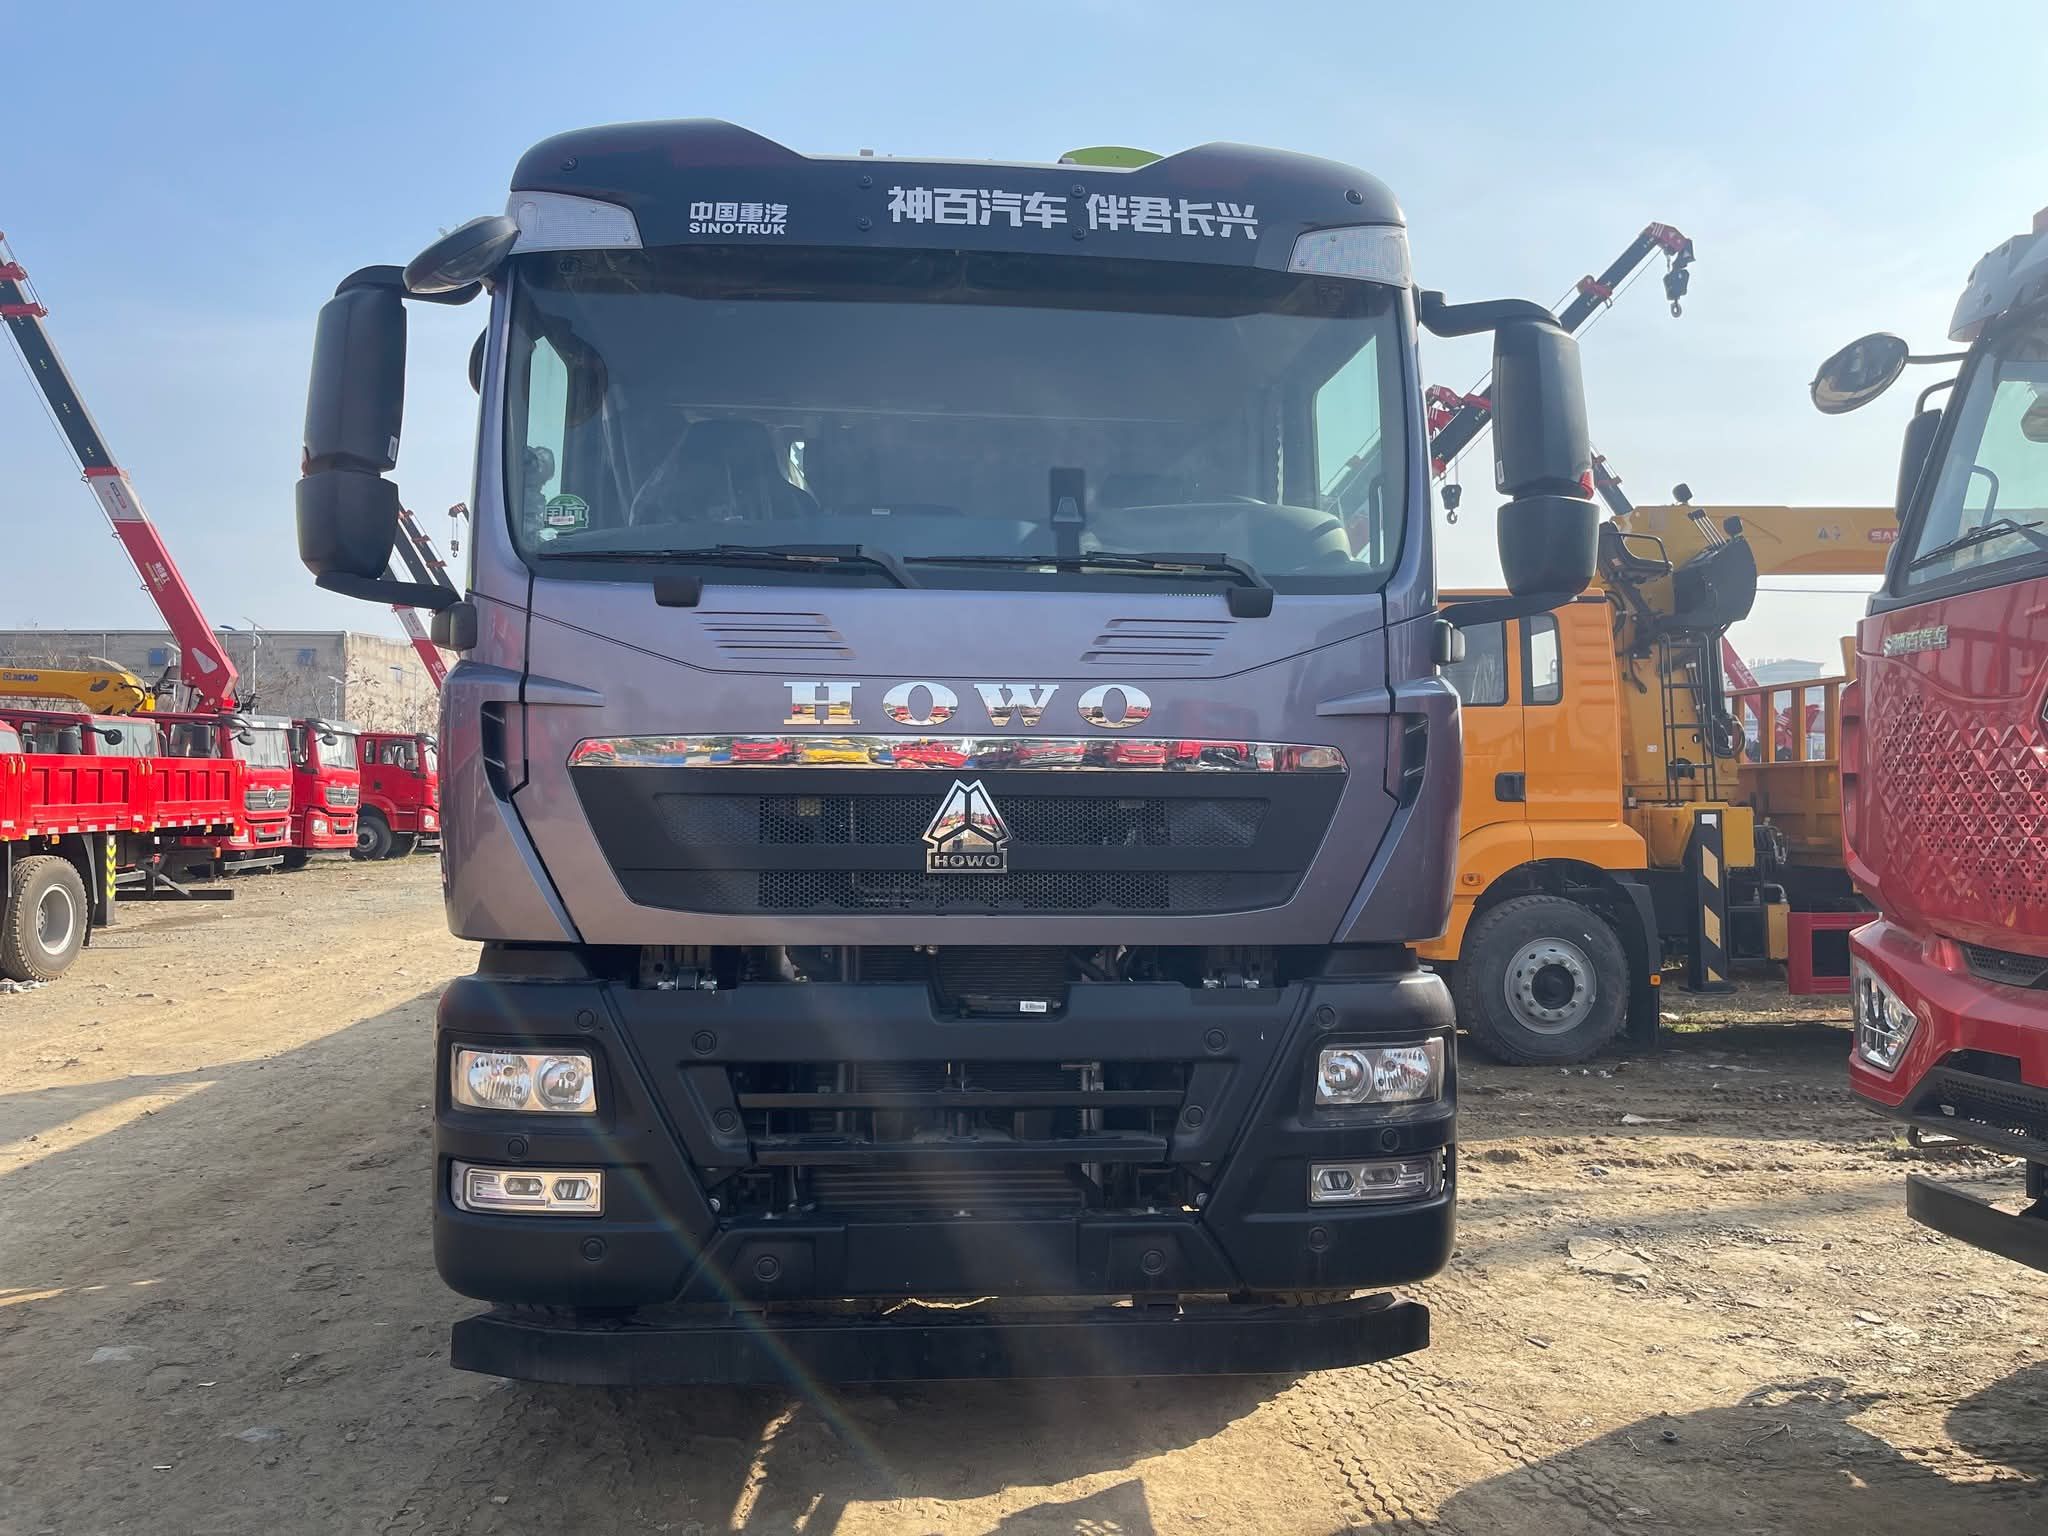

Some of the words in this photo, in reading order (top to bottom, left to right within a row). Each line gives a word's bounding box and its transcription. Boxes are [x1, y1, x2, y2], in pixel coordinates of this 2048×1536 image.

[690, 202, 788, 223] 中国重汽
[887, 185, 1068, 229] 神百汽车
[1086, 193, 1259, 240] 伴君长兴
[689, 222, 785, 235] SINOTRUK
[783, 681, 1152, 729] HOWO
[934, 855, 1000, 867] HOWO
